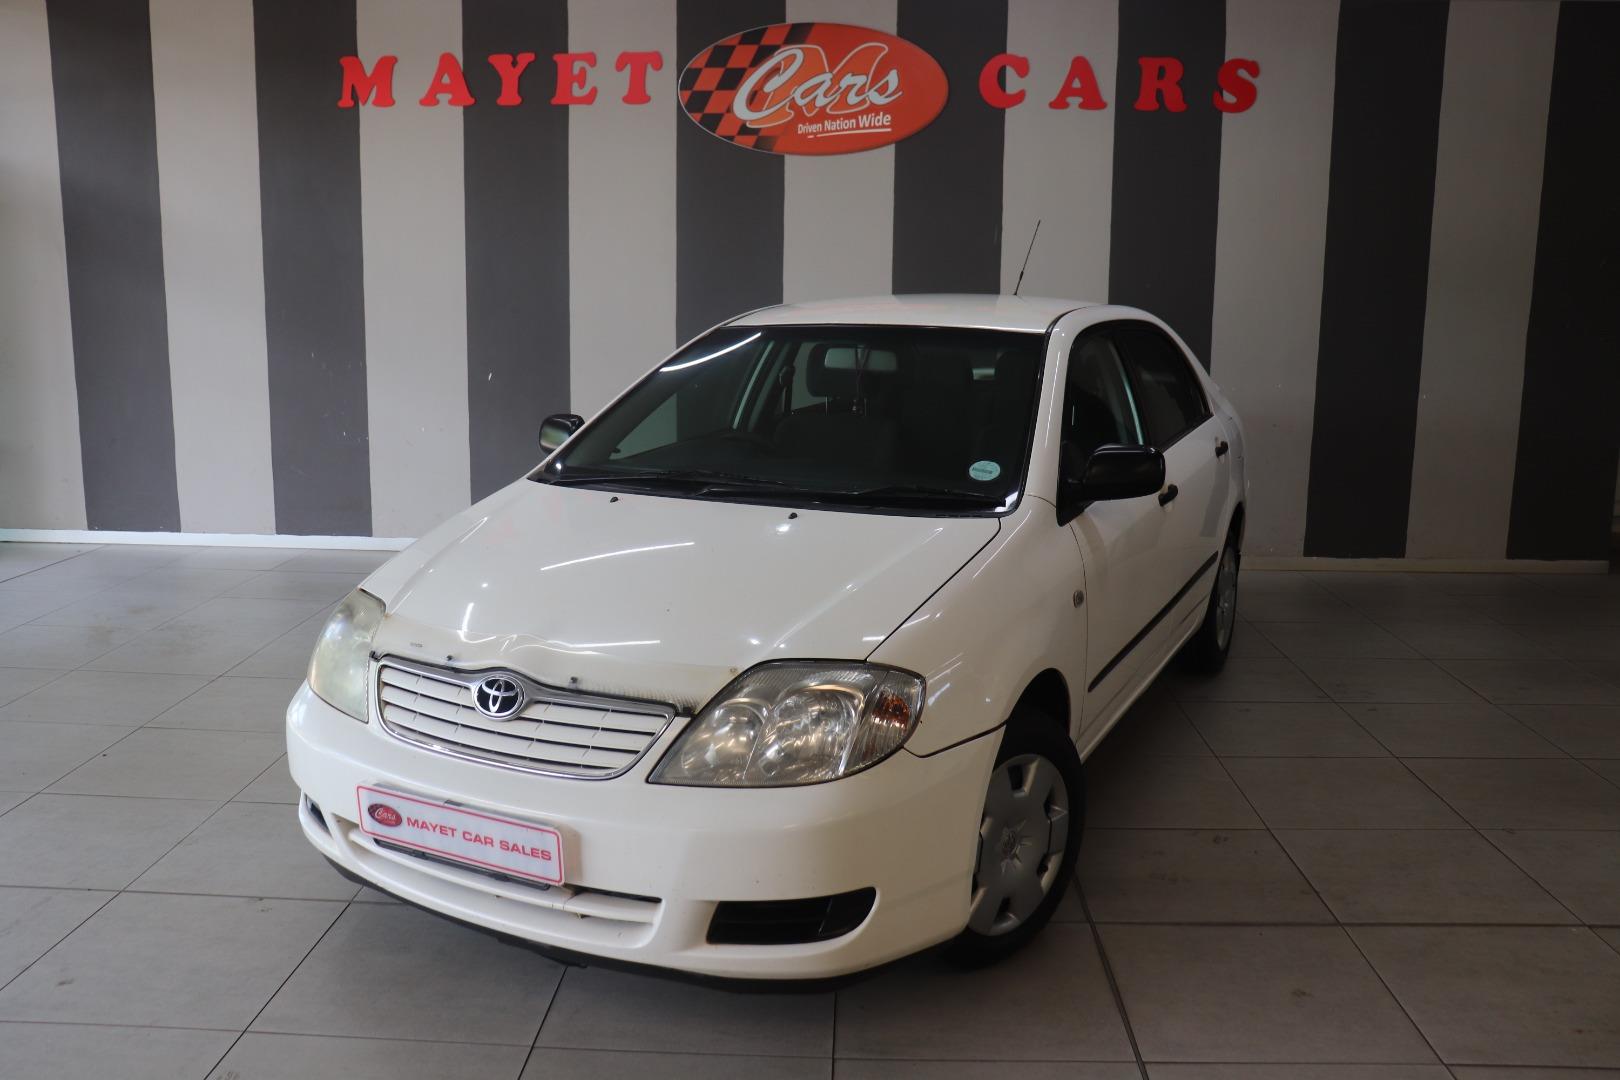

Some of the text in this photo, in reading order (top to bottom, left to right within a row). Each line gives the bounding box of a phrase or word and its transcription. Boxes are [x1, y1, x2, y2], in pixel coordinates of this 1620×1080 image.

[338, 51, 1260, 114] MAYET CARS
[733, 48, 903, 121] Cars
[797, 112, 892, 134] Driven Nation Wide
[406, 817, 552, 861] MAYET CAR SALES
